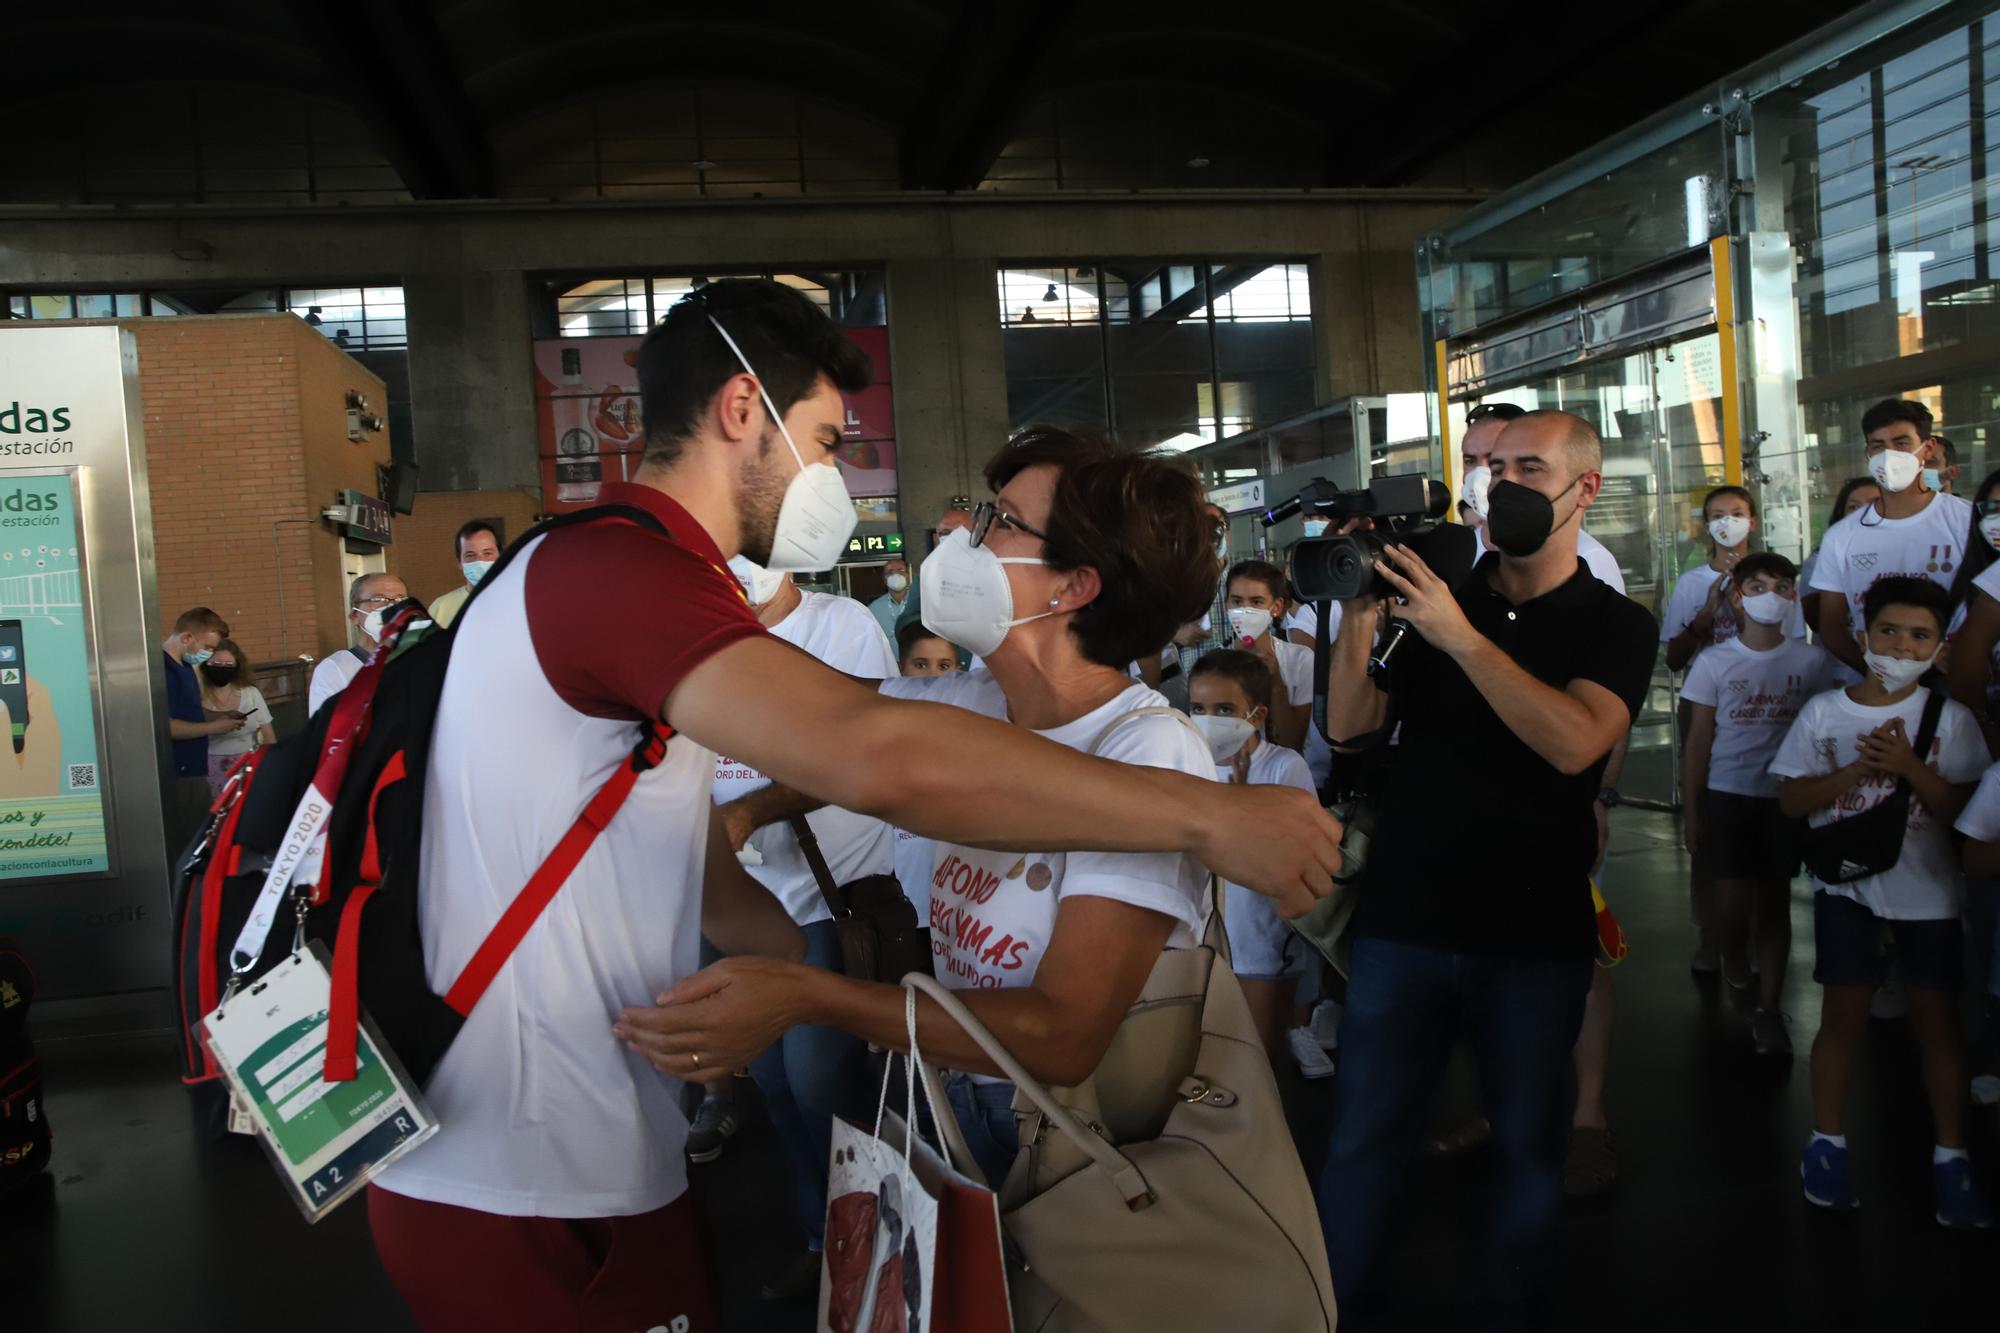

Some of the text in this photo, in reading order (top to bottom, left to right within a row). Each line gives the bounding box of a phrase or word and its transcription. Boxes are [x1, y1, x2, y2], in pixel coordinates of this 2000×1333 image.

[2, 514, 60, 527] estación
[867, 536, 885, 550] P1
[736, 769, 754, 779] DEL
[30, 811, 46, 827] y
[268, 803, 322, 895] TOKYO 2020
[395, 1116, 411, 1133] R
[313, 1166, 344, 1198] A 2
